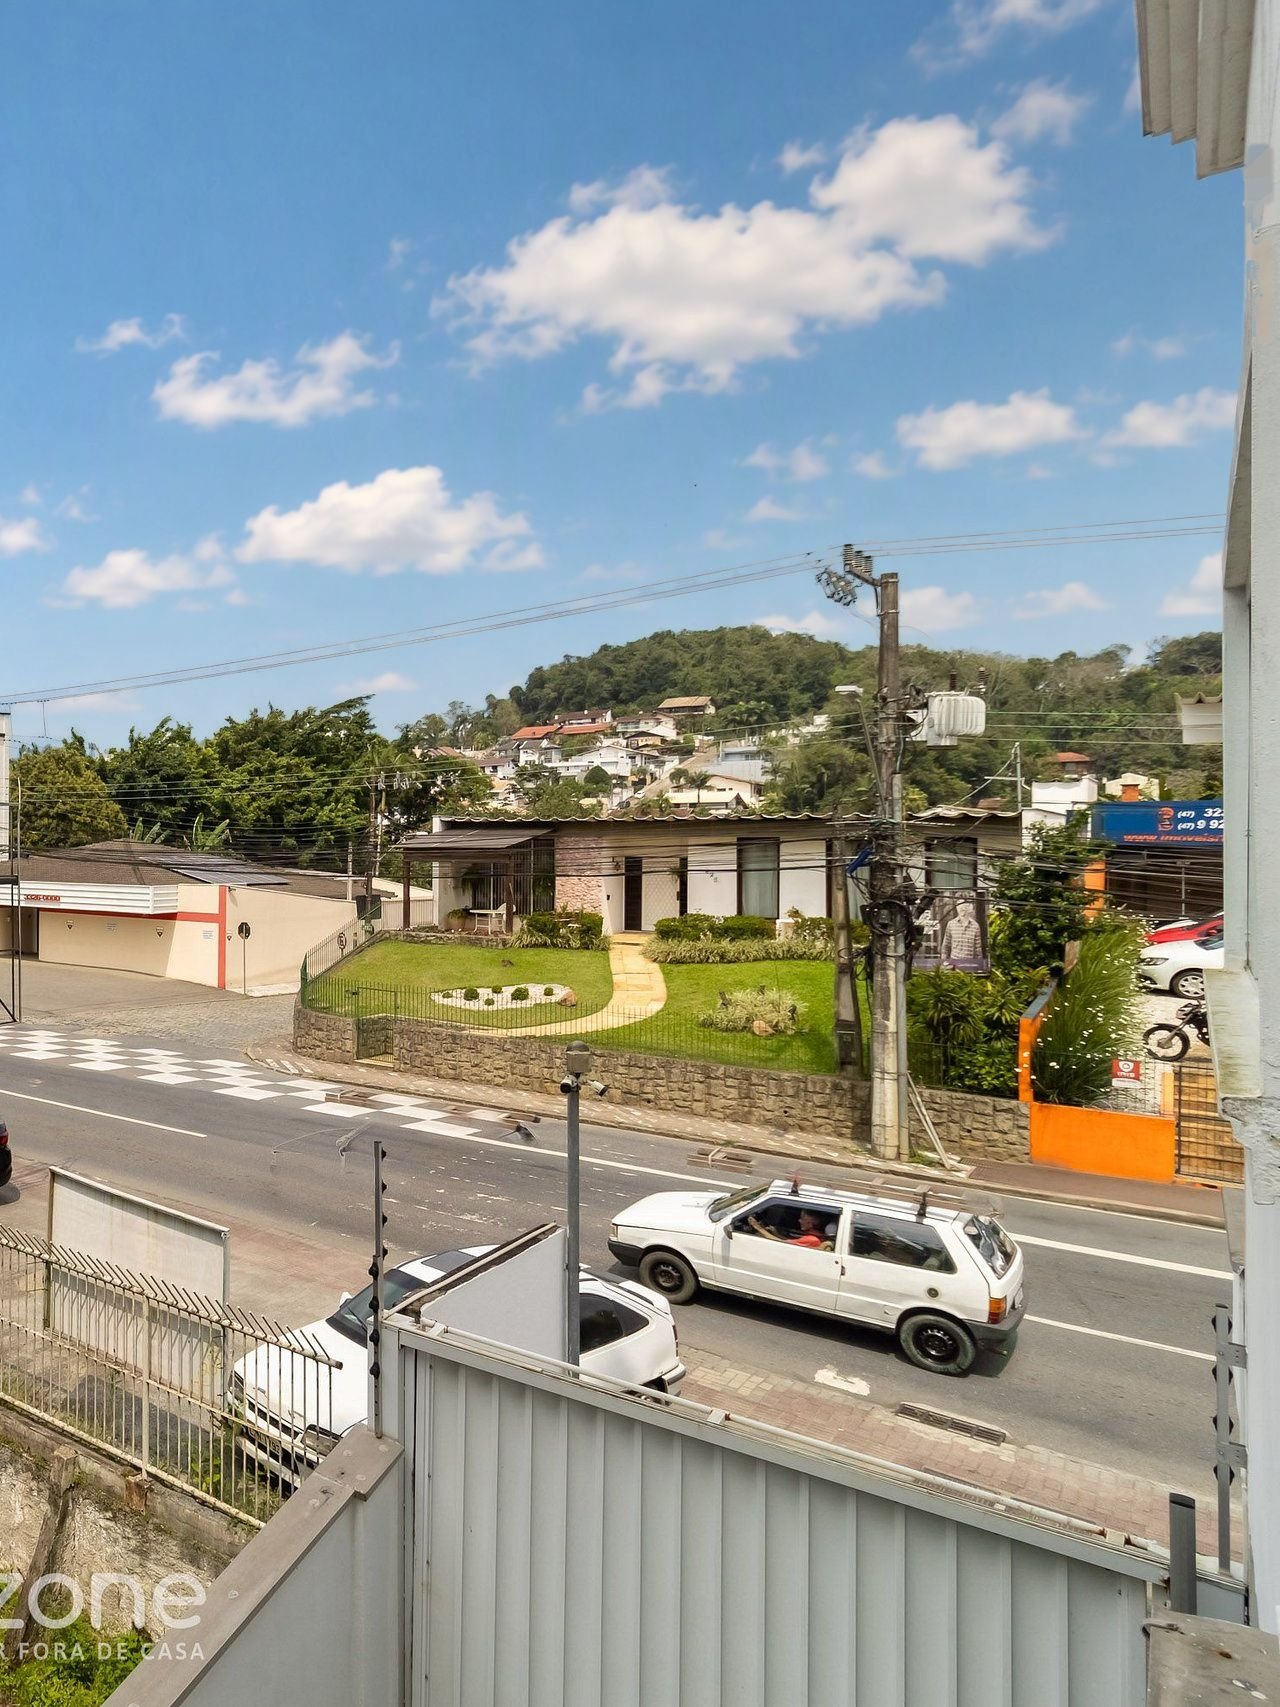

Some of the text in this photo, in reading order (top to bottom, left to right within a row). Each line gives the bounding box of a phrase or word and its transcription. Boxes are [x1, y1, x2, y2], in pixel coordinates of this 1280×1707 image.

[1177, 810, 1195, 818] (47)
[1177, 822, 1195, 830] (47)
[1196, 820, 1206, 829] 9
